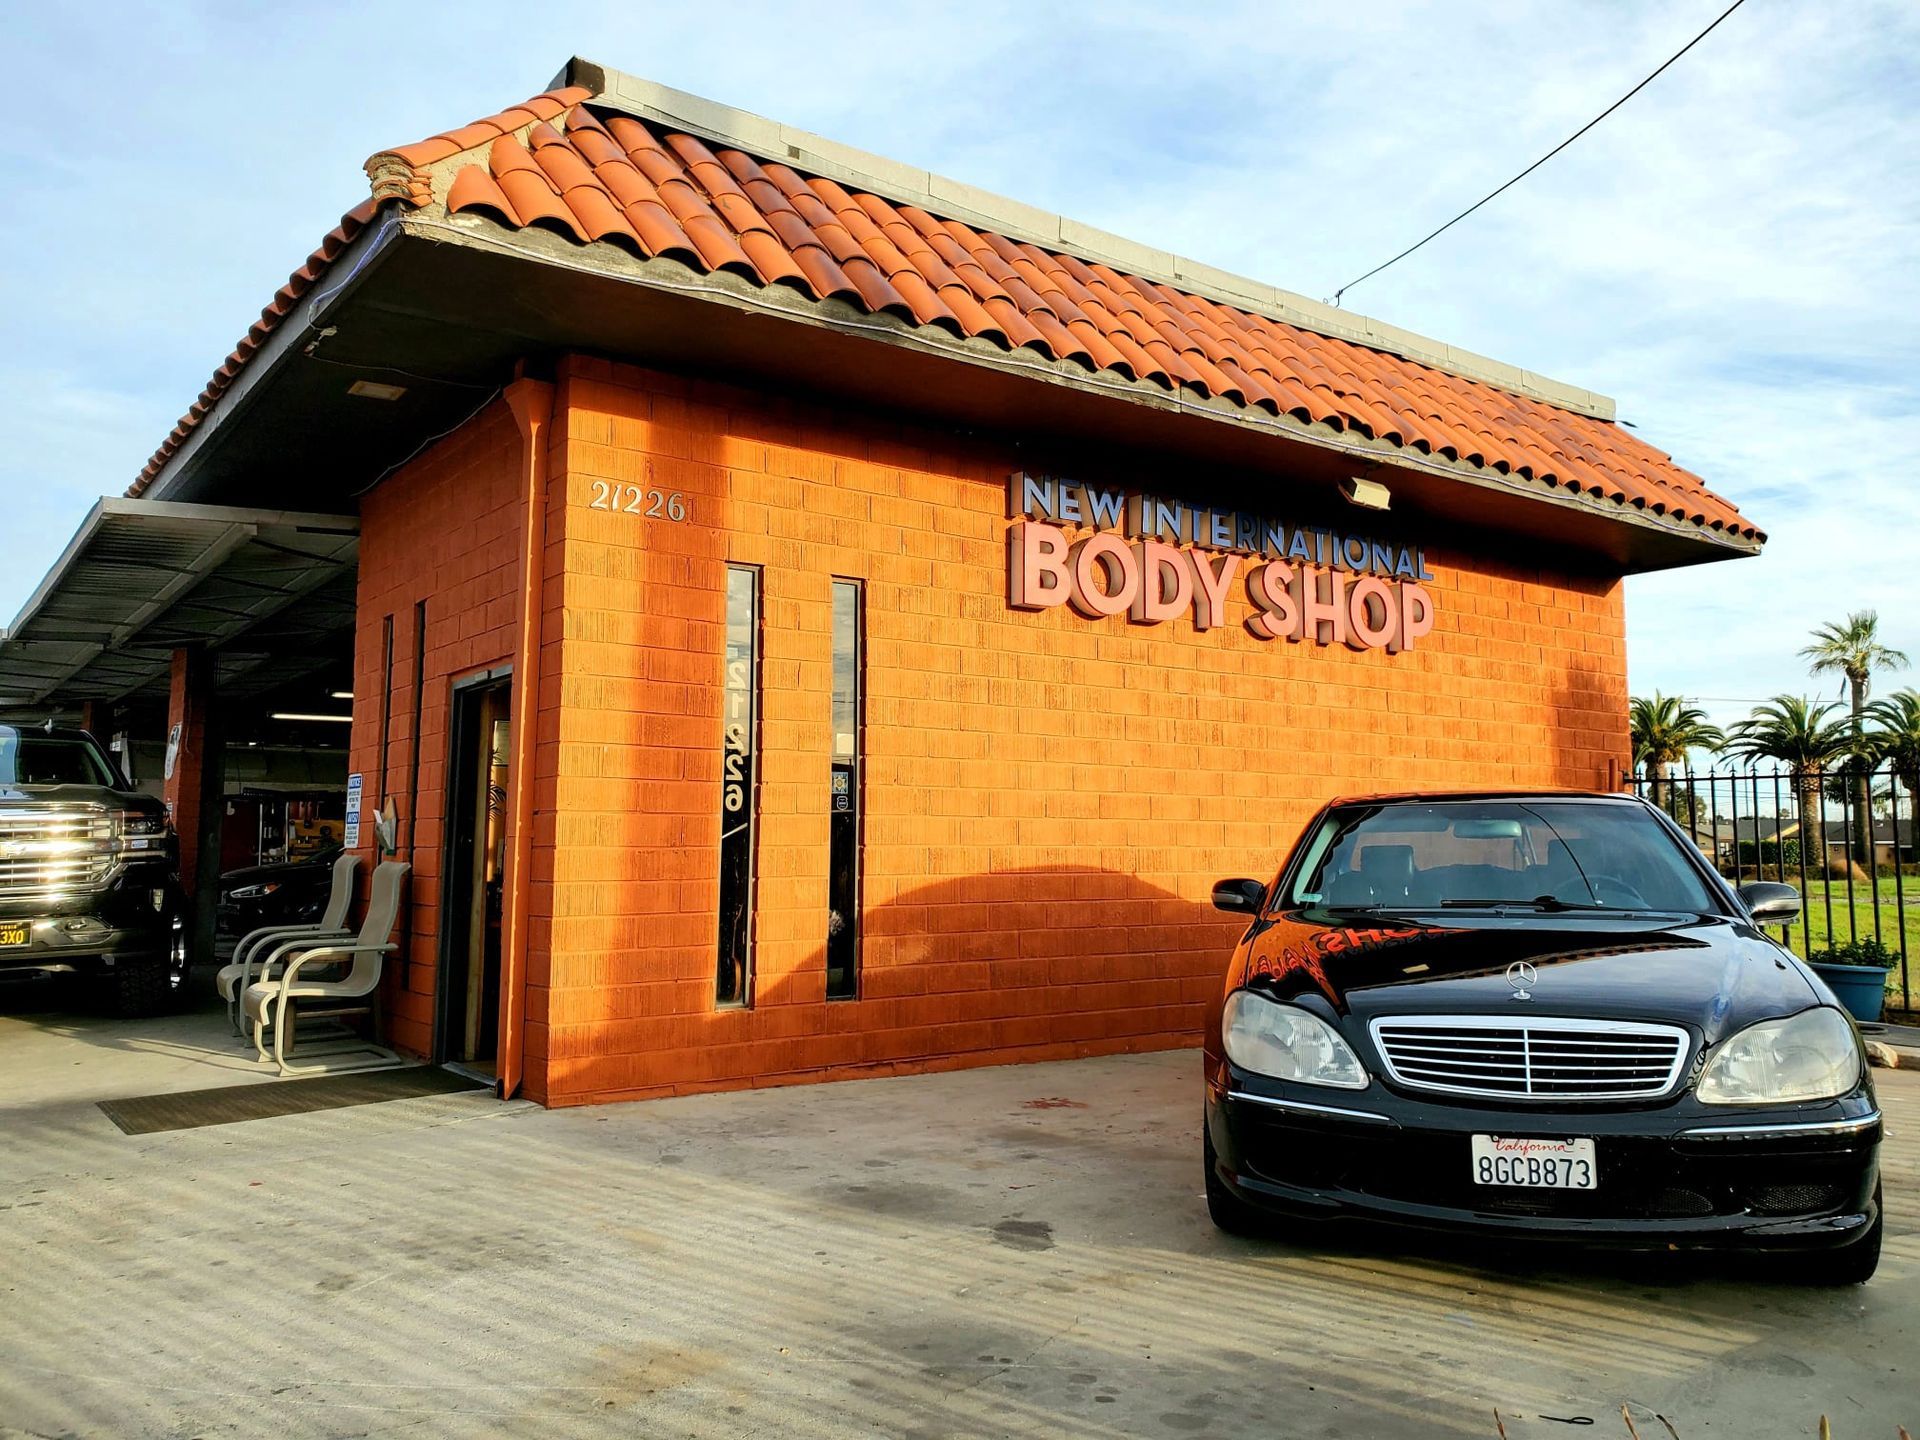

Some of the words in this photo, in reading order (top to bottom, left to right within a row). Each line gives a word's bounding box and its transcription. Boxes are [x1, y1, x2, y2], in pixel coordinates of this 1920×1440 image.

[589, 480, 686, 522] 21226
[1021, 471, 1125, 530] NEW
[1141, 495, 1434, 581] INTERNATIONAL
[1020, 522, 1242, 629] BODY
[1256, 560, 1435, 651] SHOP
[1494, 1138, 1574, 1155] California
[1478, 1156, 1591, 1188] 8GCB873
